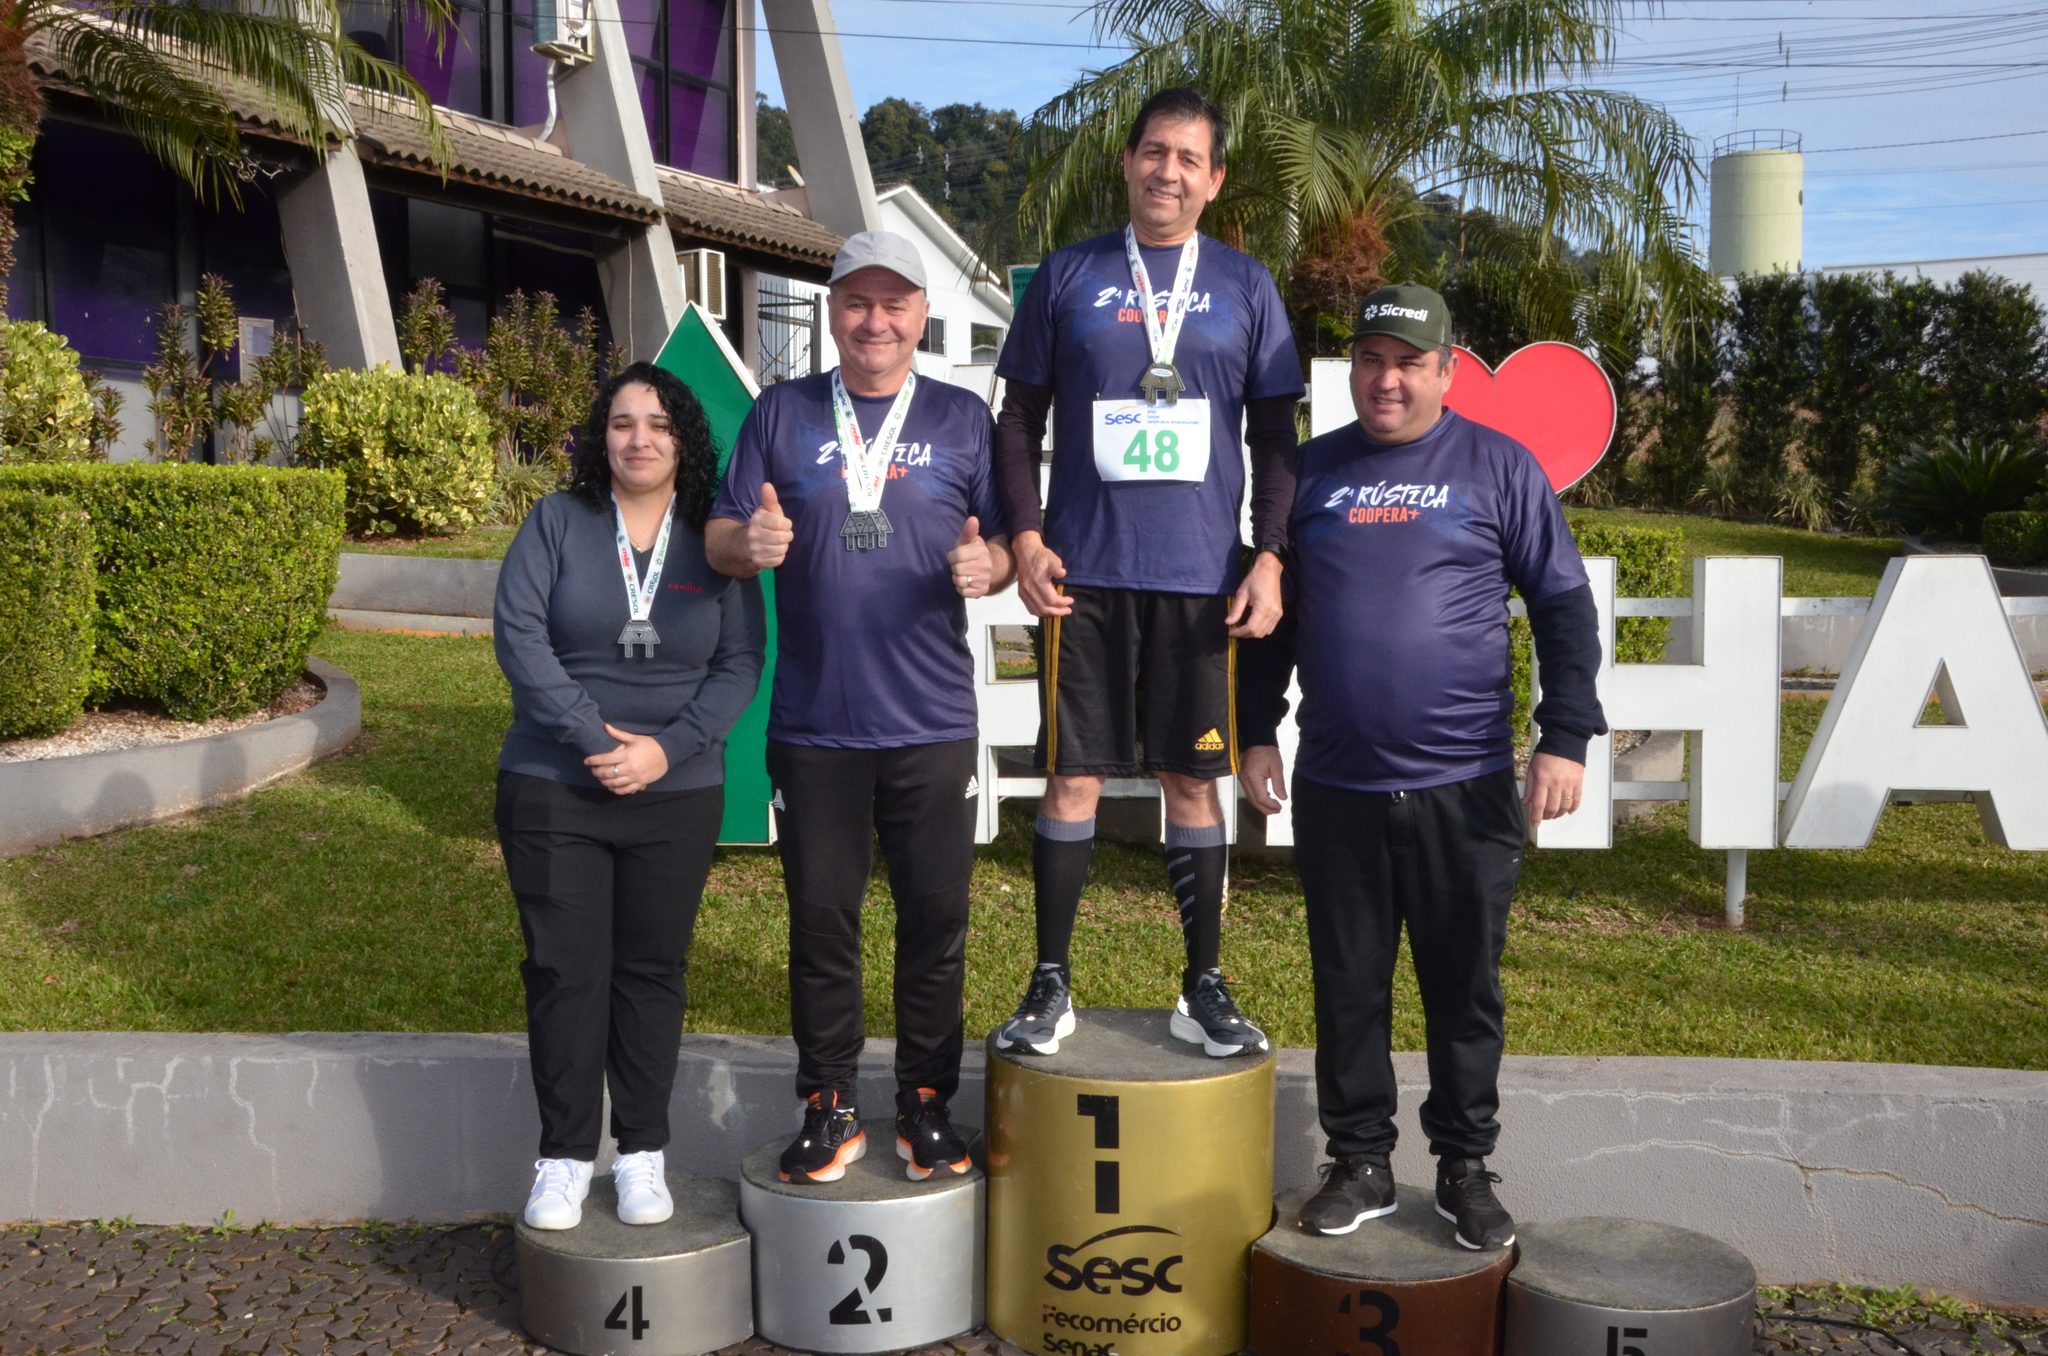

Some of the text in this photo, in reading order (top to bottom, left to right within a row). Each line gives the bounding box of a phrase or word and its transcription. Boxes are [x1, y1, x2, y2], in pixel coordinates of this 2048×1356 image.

[1378, 304, 1428, 323] Sicredi
[881, 426, 897, 457] CRESOL
[1123, 429, 1180, 473] 48
[1356, 480, 1449, 508] RÚSTICA
[1349, 506, 1421, 523] COOPERA+
[628, 583, 640, 616] CRESOL
[1195, 742, 1224, 751] adidas
[1076, 1093, 1120, 1215] 1
[827, 1234, 893, 1325] 2
[1044, 1243, 1183, 1297] Sesc
[604, 1285, 650, 1340] 4
[1337, 1290, 1400, 1356] 3
